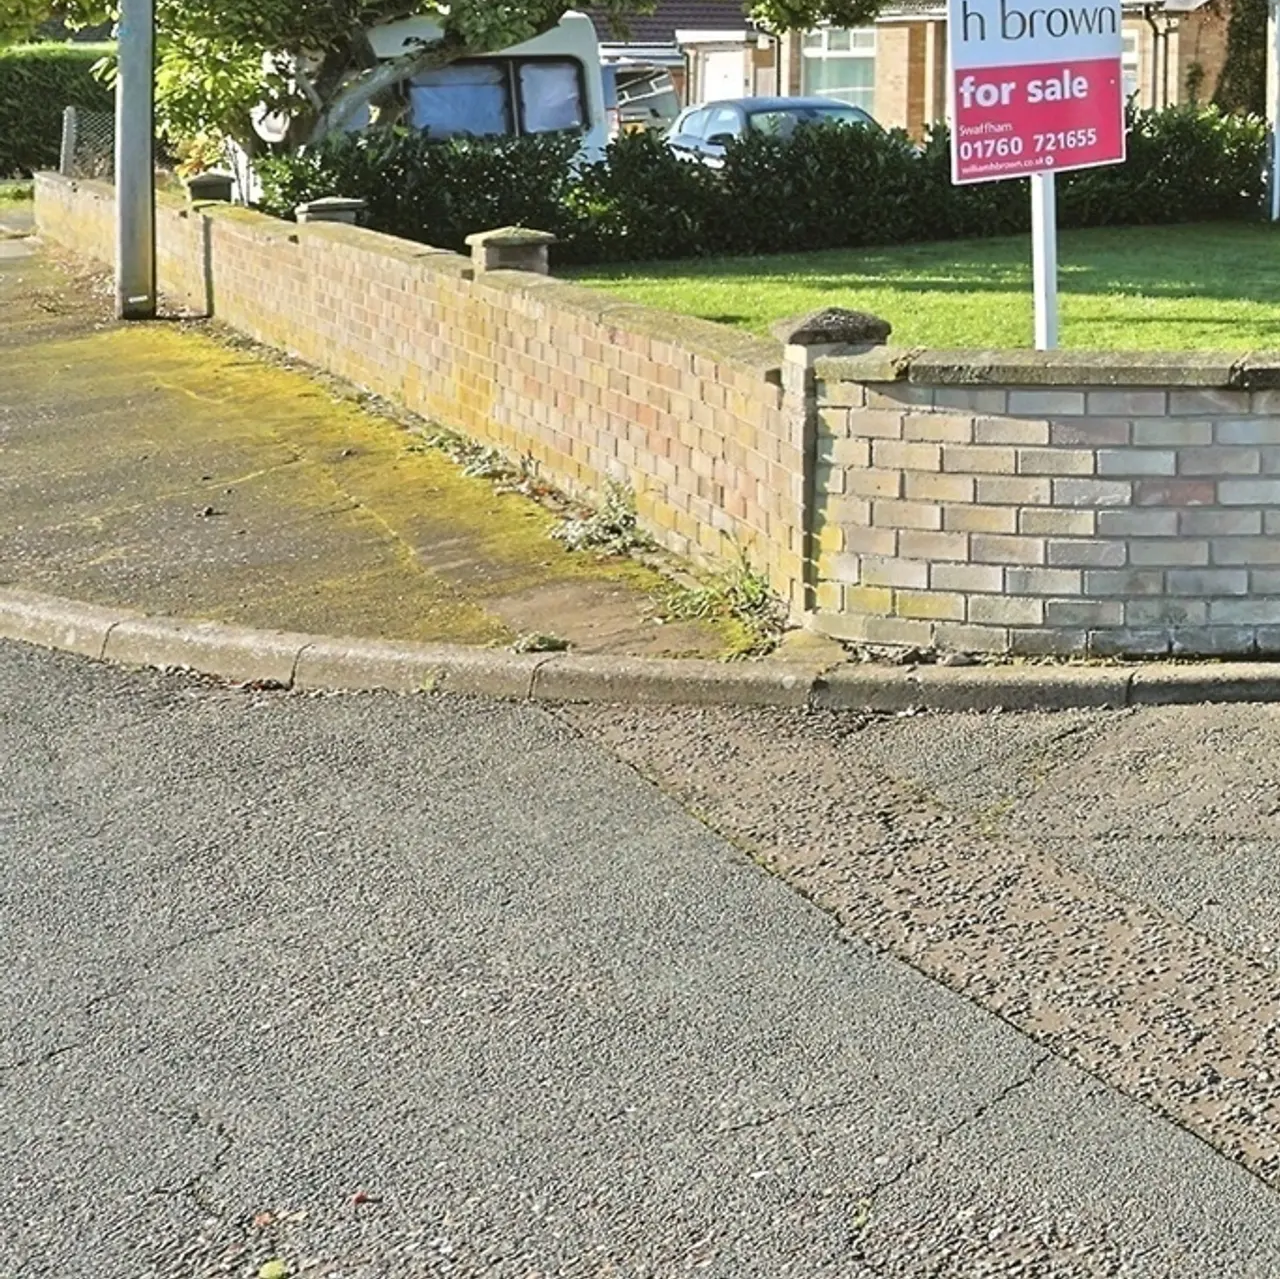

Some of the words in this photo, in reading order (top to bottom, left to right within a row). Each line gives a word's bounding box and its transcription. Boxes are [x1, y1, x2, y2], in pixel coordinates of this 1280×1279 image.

[962, 0, 986, 41] h
[1001, 0, 1116, 40] brown
[959, 75, 1016, 108] for
[1027, 69, 1088, 104] sale
[959, 122, 1013, 137] Swaffham
[960, 136, 1023, 161] 01760
[1033, 128, 1097, 152] 721655
